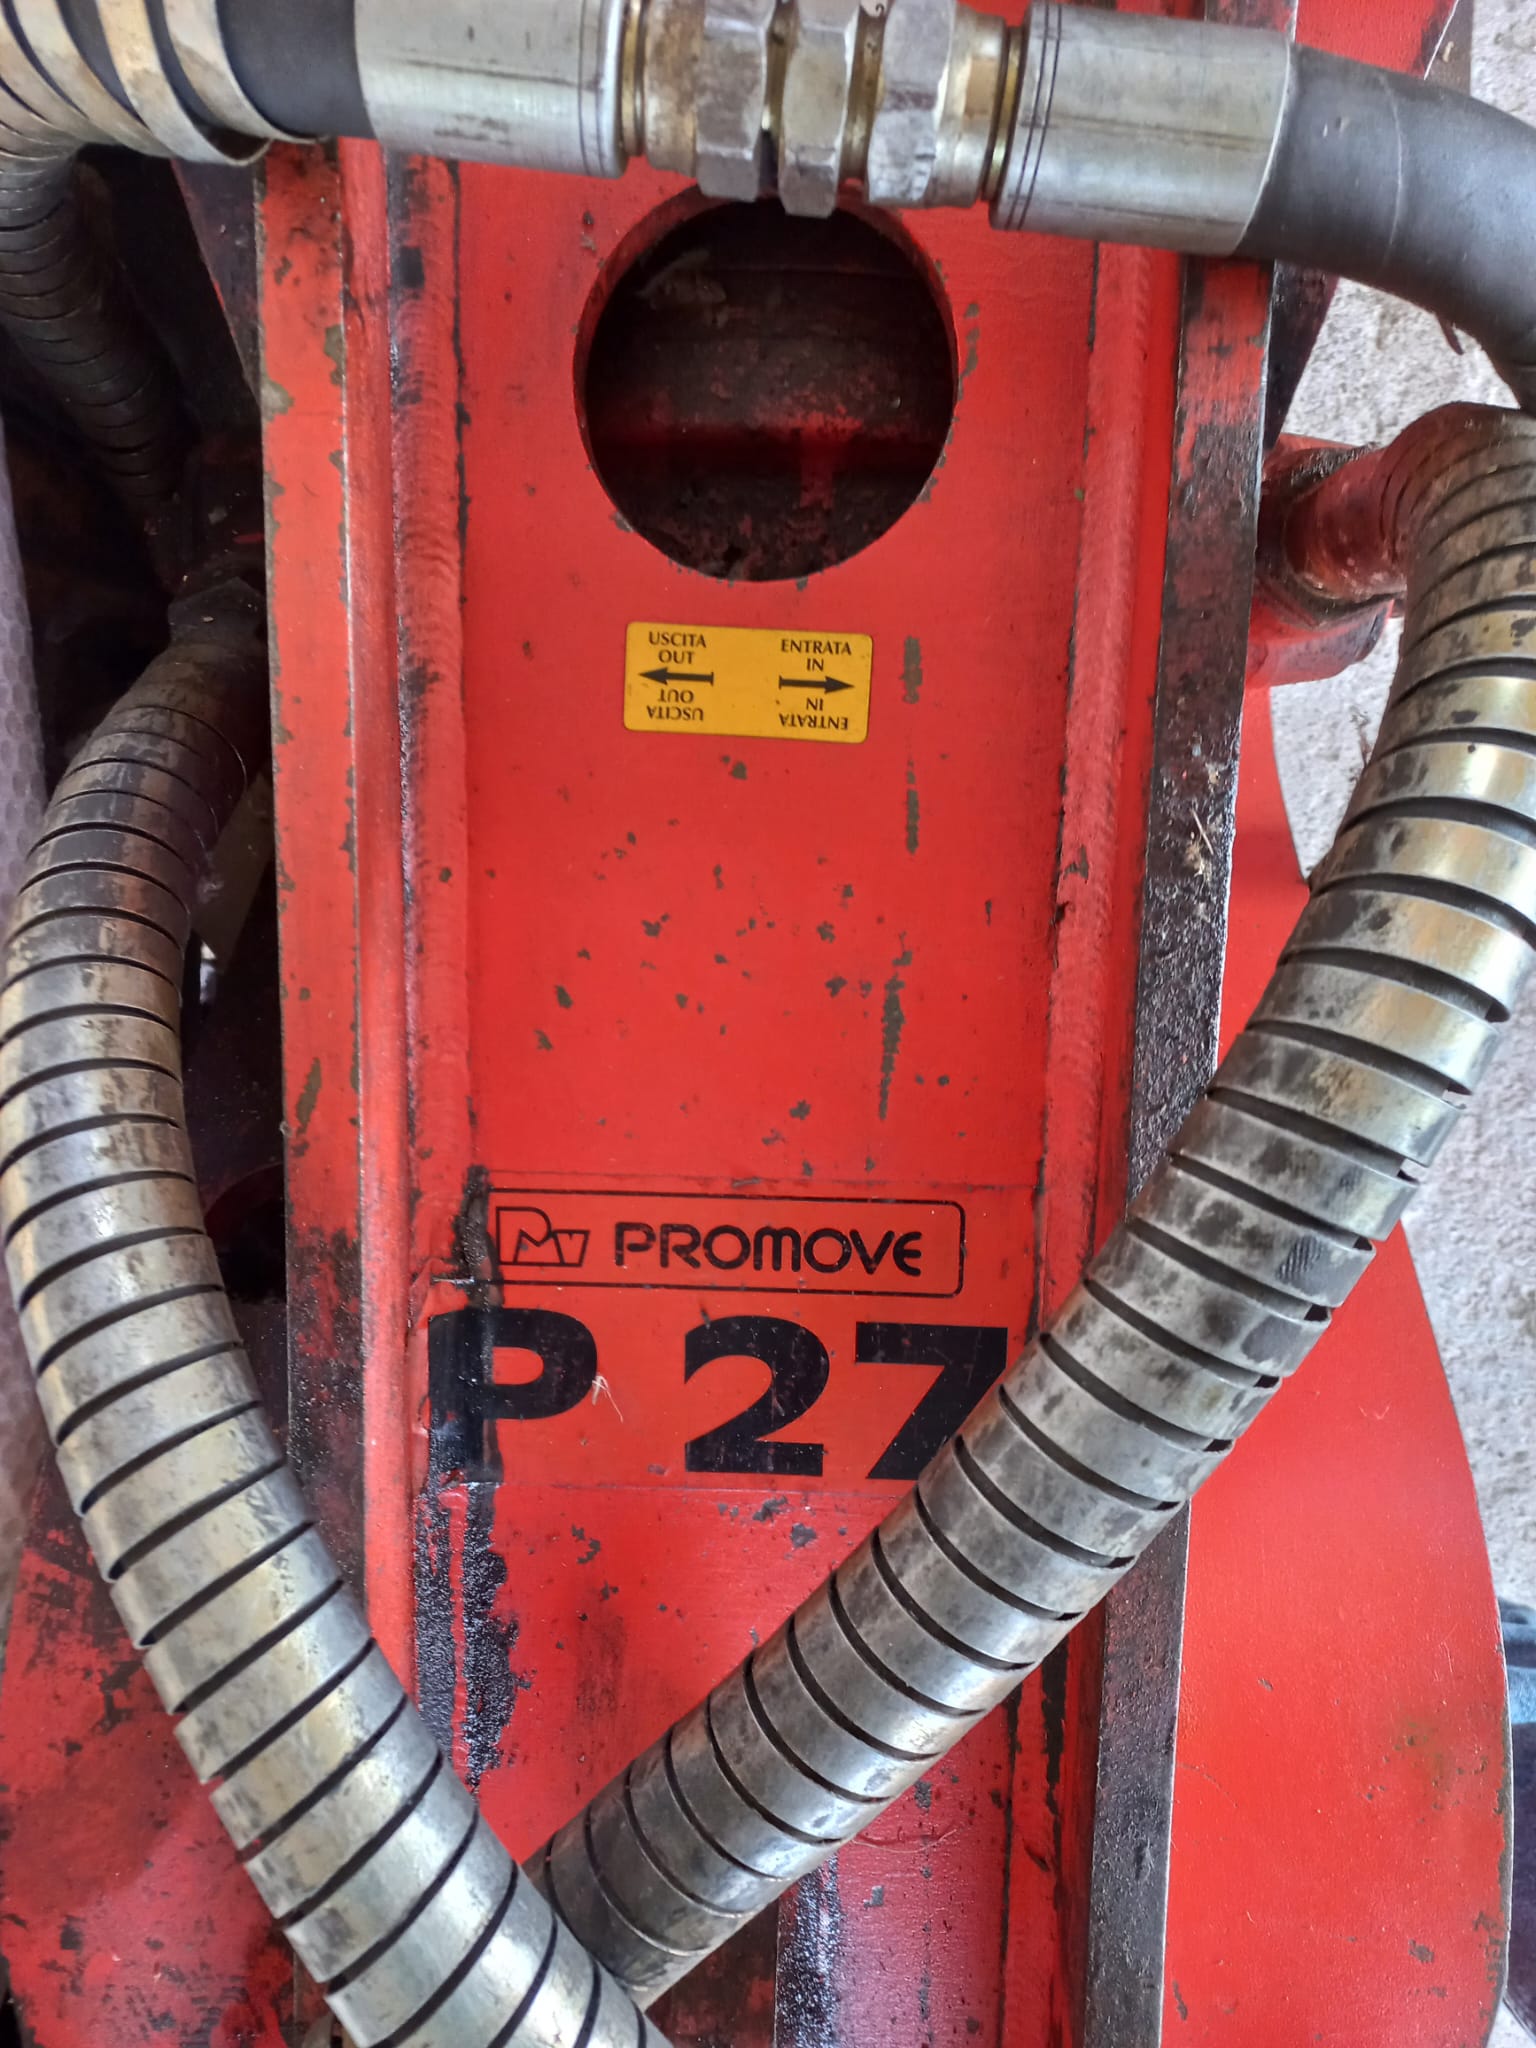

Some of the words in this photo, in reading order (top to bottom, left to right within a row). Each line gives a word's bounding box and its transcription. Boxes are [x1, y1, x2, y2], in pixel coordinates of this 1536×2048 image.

[648, 631, 707, 648] USCITA
[781, 639, 852, 656] ENTRATA
[658, 649, 695, 665] OUT
[806, 658, 824, 672] IN
[658, 689, 694, 704] OUT
[806, 697, 823, 712] IN
[647, 705, 704, 721] USCITA
[779, 713, 849, 731] ENTRATA
[615, 1221, 921, 1277] PROMOVE
[428, 1308, 597, 1478] P
[683, 1315, 1008, 1480] 27
